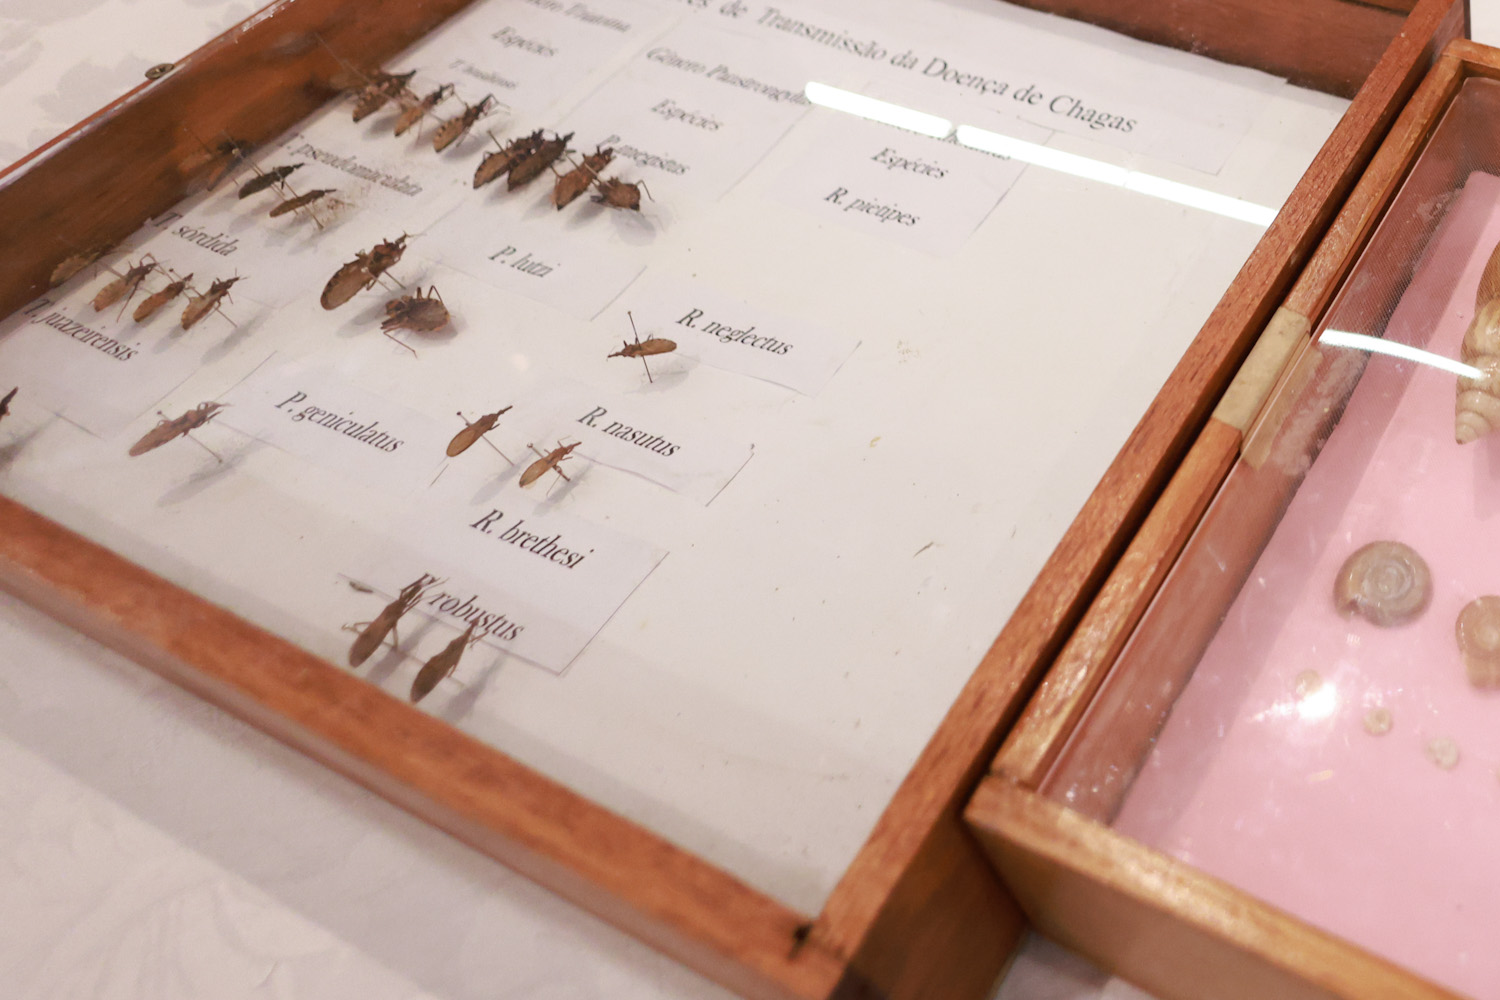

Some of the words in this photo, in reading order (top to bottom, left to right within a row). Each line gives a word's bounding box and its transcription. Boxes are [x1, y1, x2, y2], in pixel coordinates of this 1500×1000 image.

[890, 49, 920, 70] da
[922, 57, 1010, 96] Doença
[1013, 84, 1044, 106] de
[1049, 94, 1139, 133] Chagas
[823, 187, 849, 205] R.
[487, 245, 516, 264] P.
[510, 252, 562, 278] lutzi
[23, 299, 56, 318] T.
[31, 306, 139, 361] juazeirensis
[675, 307, 704, 329] R.
[700, 319, 795, 356] neglectus
[274, 390, 306, 414] P.
[293, 399, 405, 455] geniculatus
[577, 405, 602, 428] R.
[601, 418, 682, 458] nasutus
[469, 508, 500, 536] R.
[498, 520, 595, 570] brethesi
[427, 592, 525, 641] robustus
